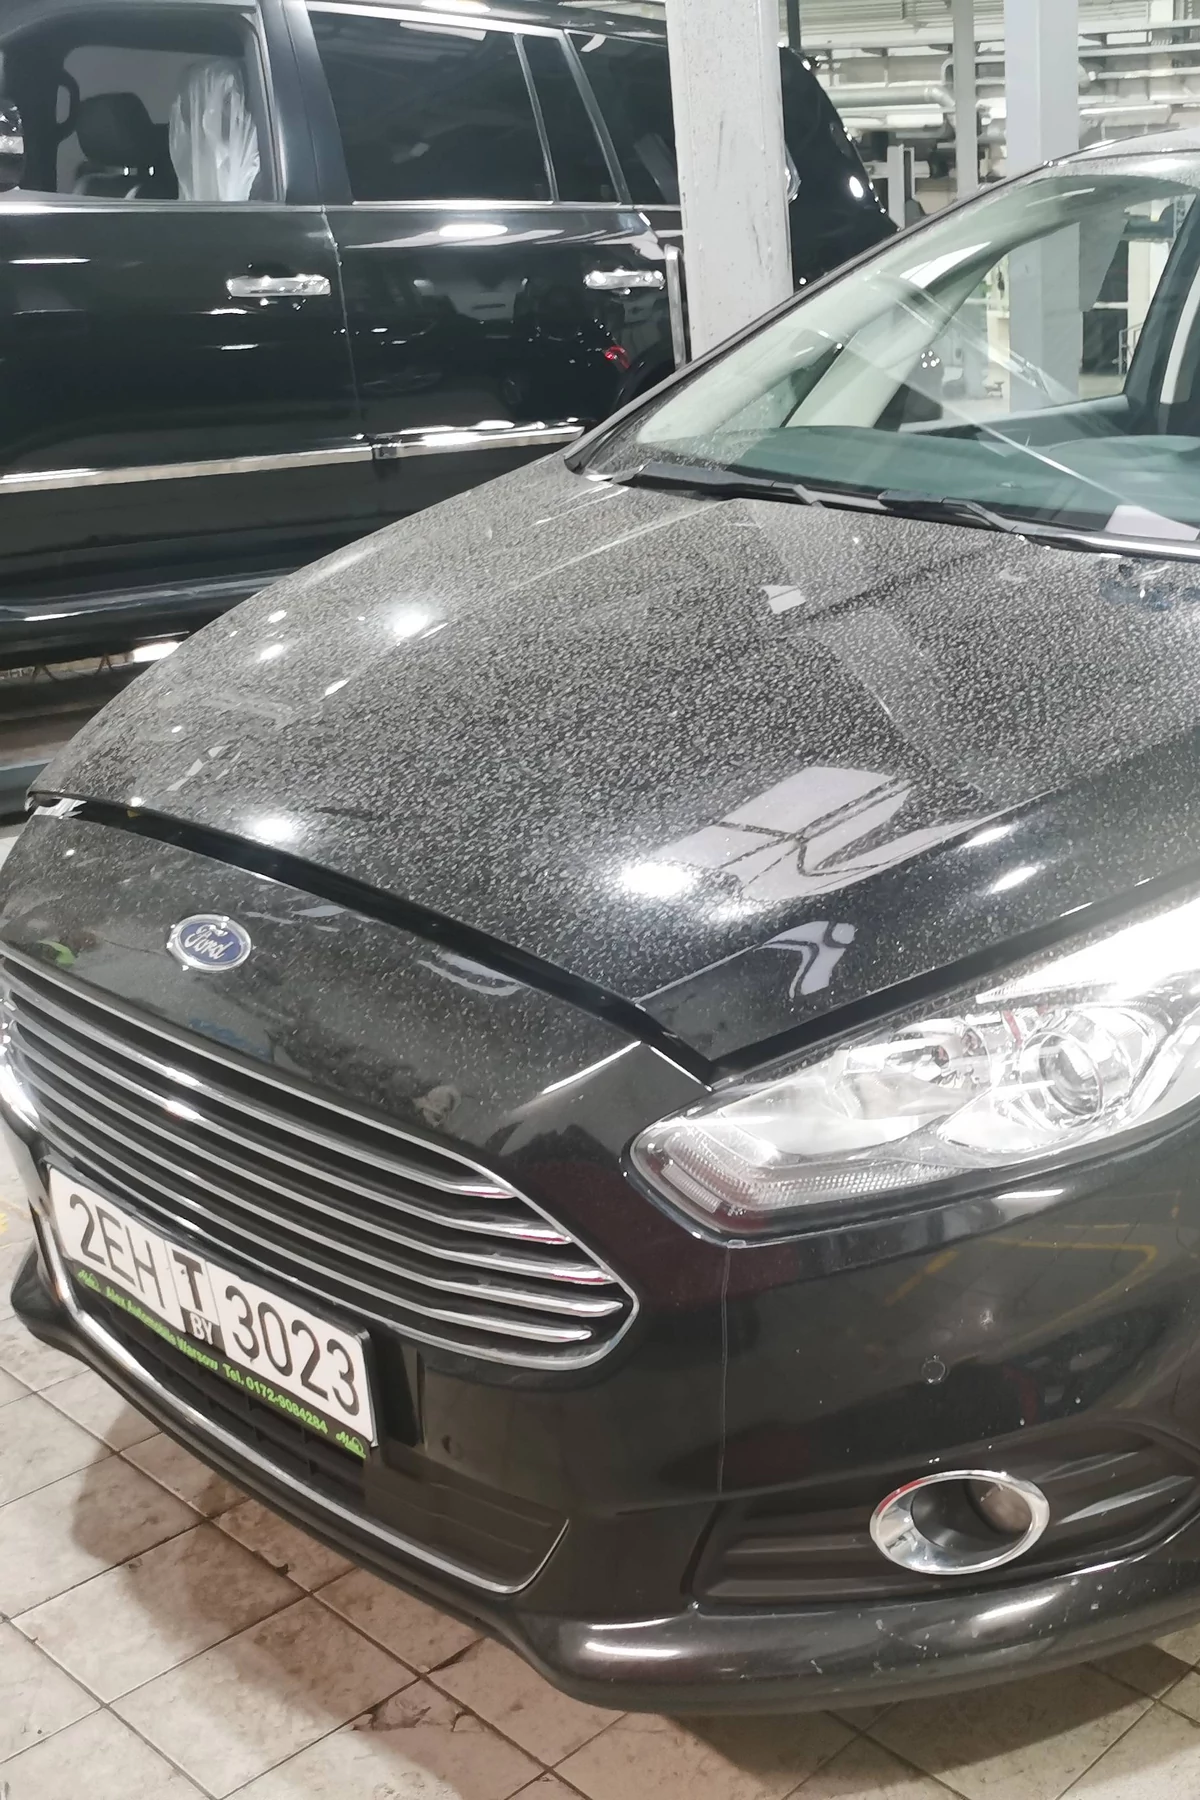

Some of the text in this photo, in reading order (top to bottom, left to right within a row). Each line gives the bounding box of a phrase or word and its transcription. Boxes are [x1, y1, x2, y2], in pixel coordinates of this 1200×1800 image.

[184, 924, 234, 960] Ford
[69, 1194, 360, 1416] 2EH T 3023
[189, 1312, 214, 1345] BY
[222, 1363, 244, 1385] Tel.
